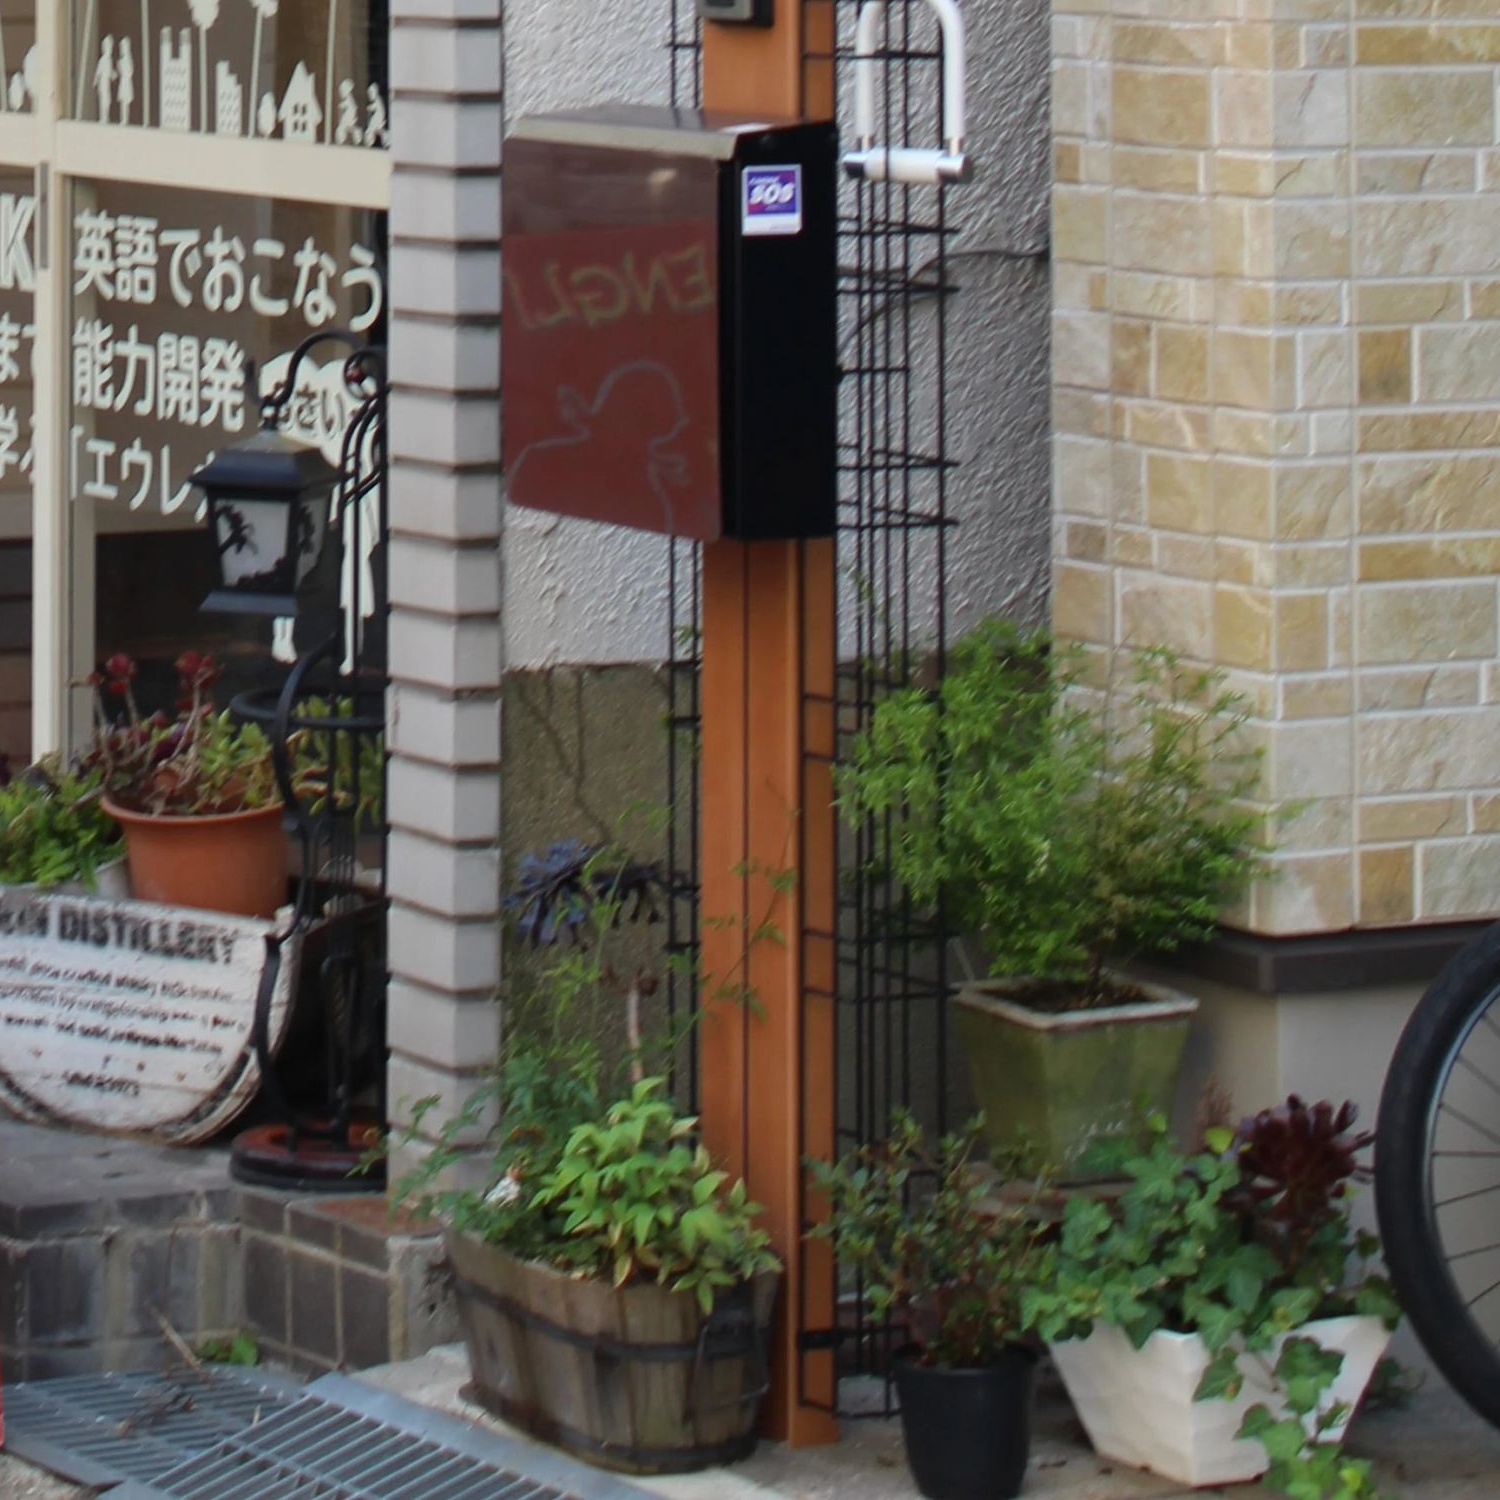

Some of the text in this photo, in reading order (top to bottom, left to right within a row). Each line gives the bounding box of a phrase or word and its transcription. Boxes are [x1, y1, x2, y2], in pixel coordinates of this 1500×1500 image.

[73, 208, 382, 332] 英語でおこなう
[72, 315, 245, 432] 能力開発
[59, 905, 239, 964] DISTILLERY
